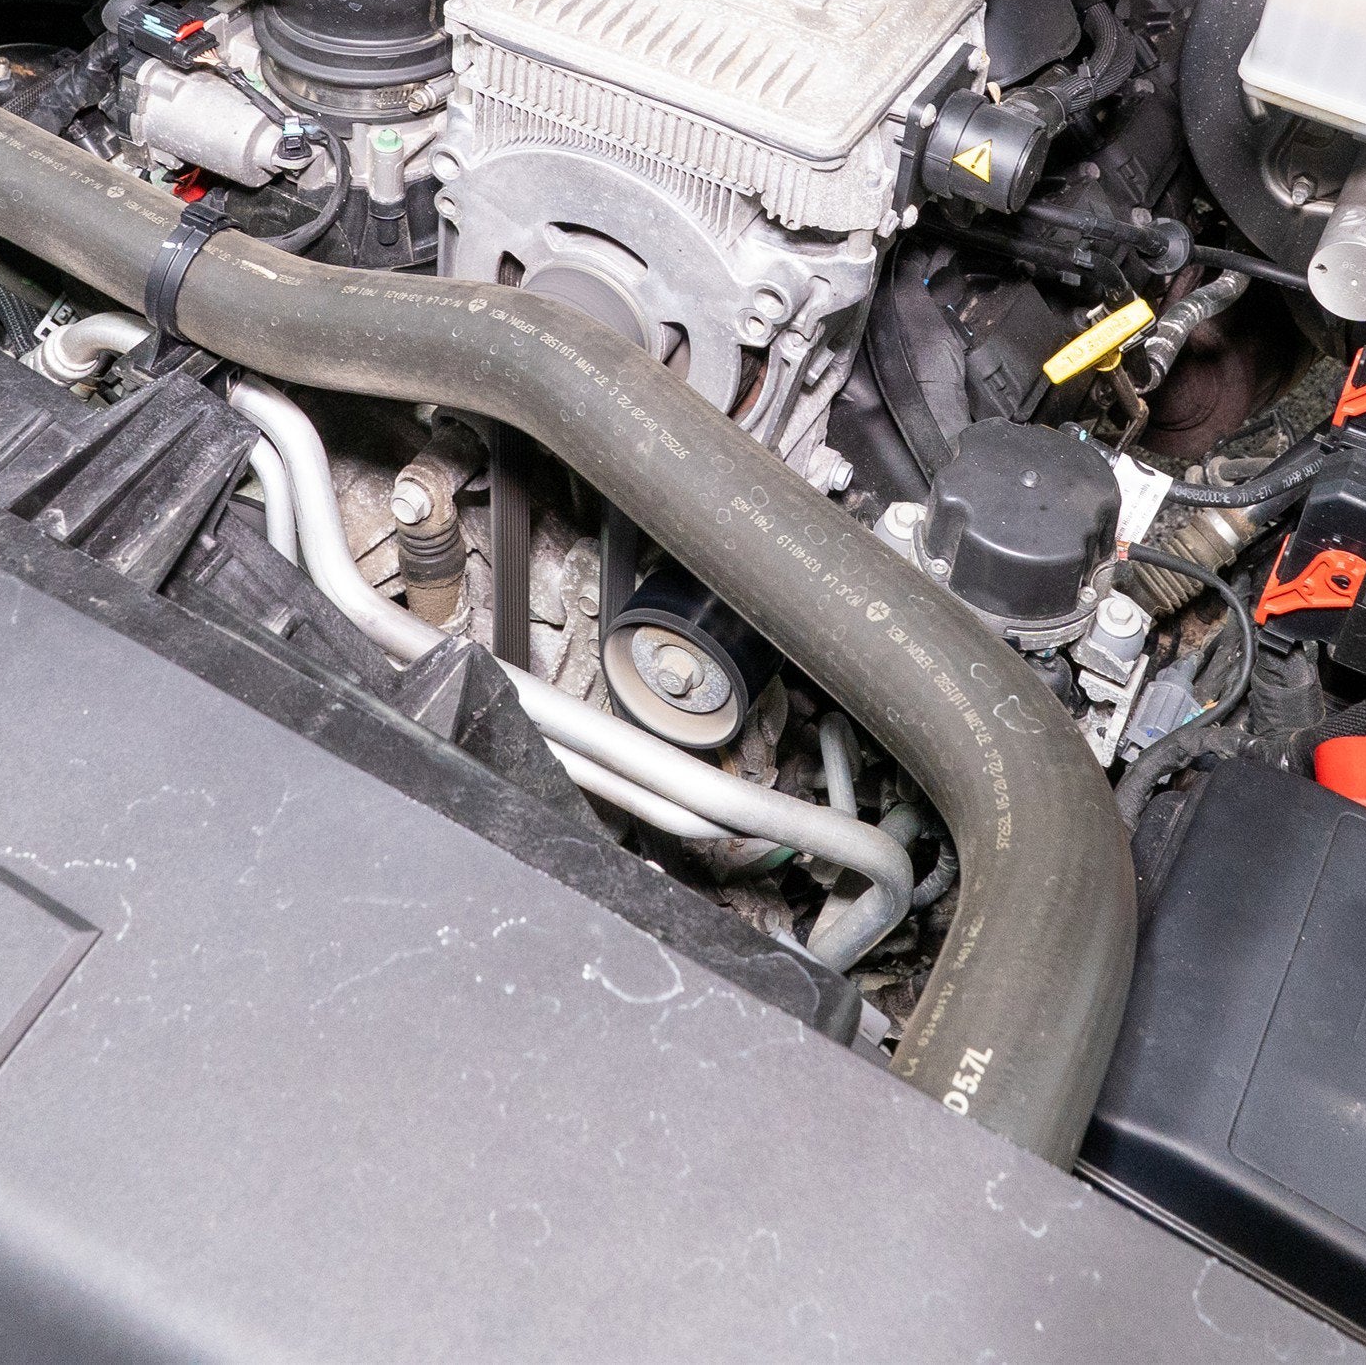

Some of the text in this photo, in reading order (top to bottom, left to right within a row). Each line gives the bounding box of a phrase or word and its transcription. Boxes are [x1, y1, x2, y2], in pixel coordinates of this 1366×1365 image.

[606, 384, 620, 398] C
[615, 391, 660, 434] 05/20/22
[729, 494, 752, 514] AGS
[747, 508, 775, 533] 7401
[774, 532, 822, 573] 03:40:19
[820, 571, 839, 589] L4
[948, 1037, 997, 1096] 5.7L
